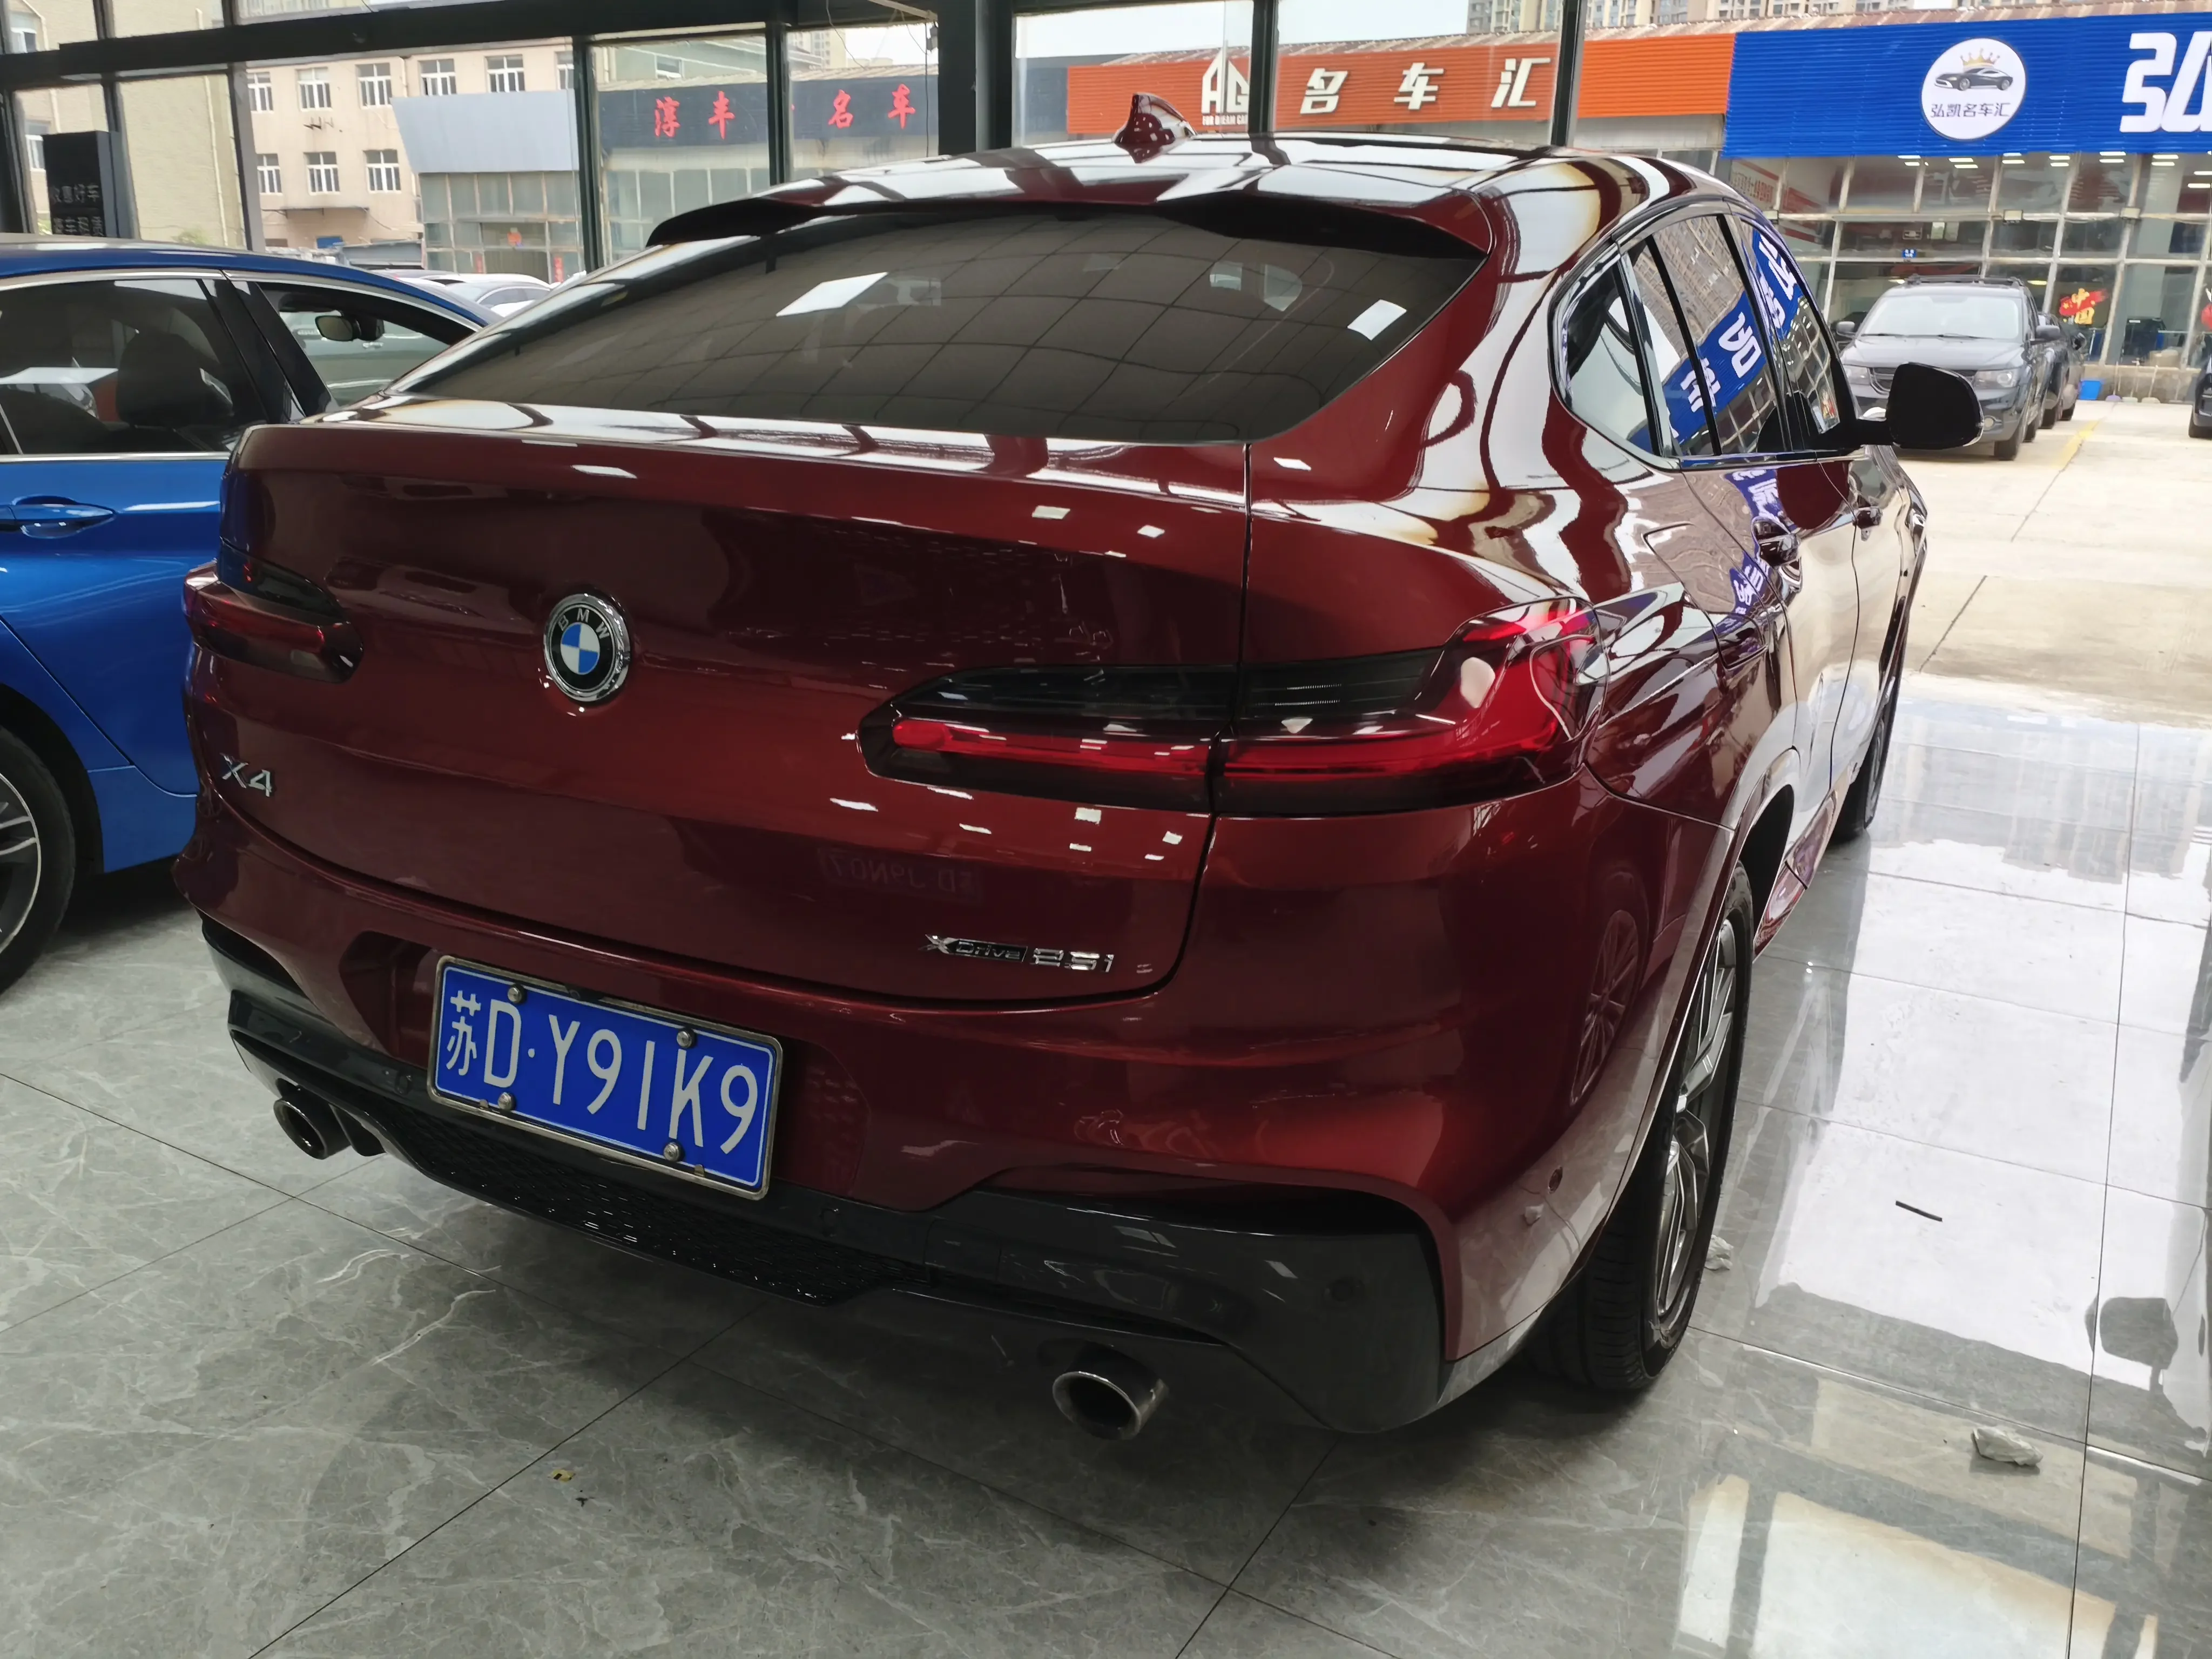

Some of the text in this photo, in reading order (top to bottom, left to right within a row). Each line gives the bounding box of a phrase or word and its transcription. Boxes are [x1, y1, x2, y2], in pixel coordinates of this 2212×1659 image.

[1300, 58, 1551, 114] 名车汇
[1931, 103, 2011, 118] 弘凯名车汇
[557, 608, 610, 639] BMW
[220, 753, 274, 798] X4
